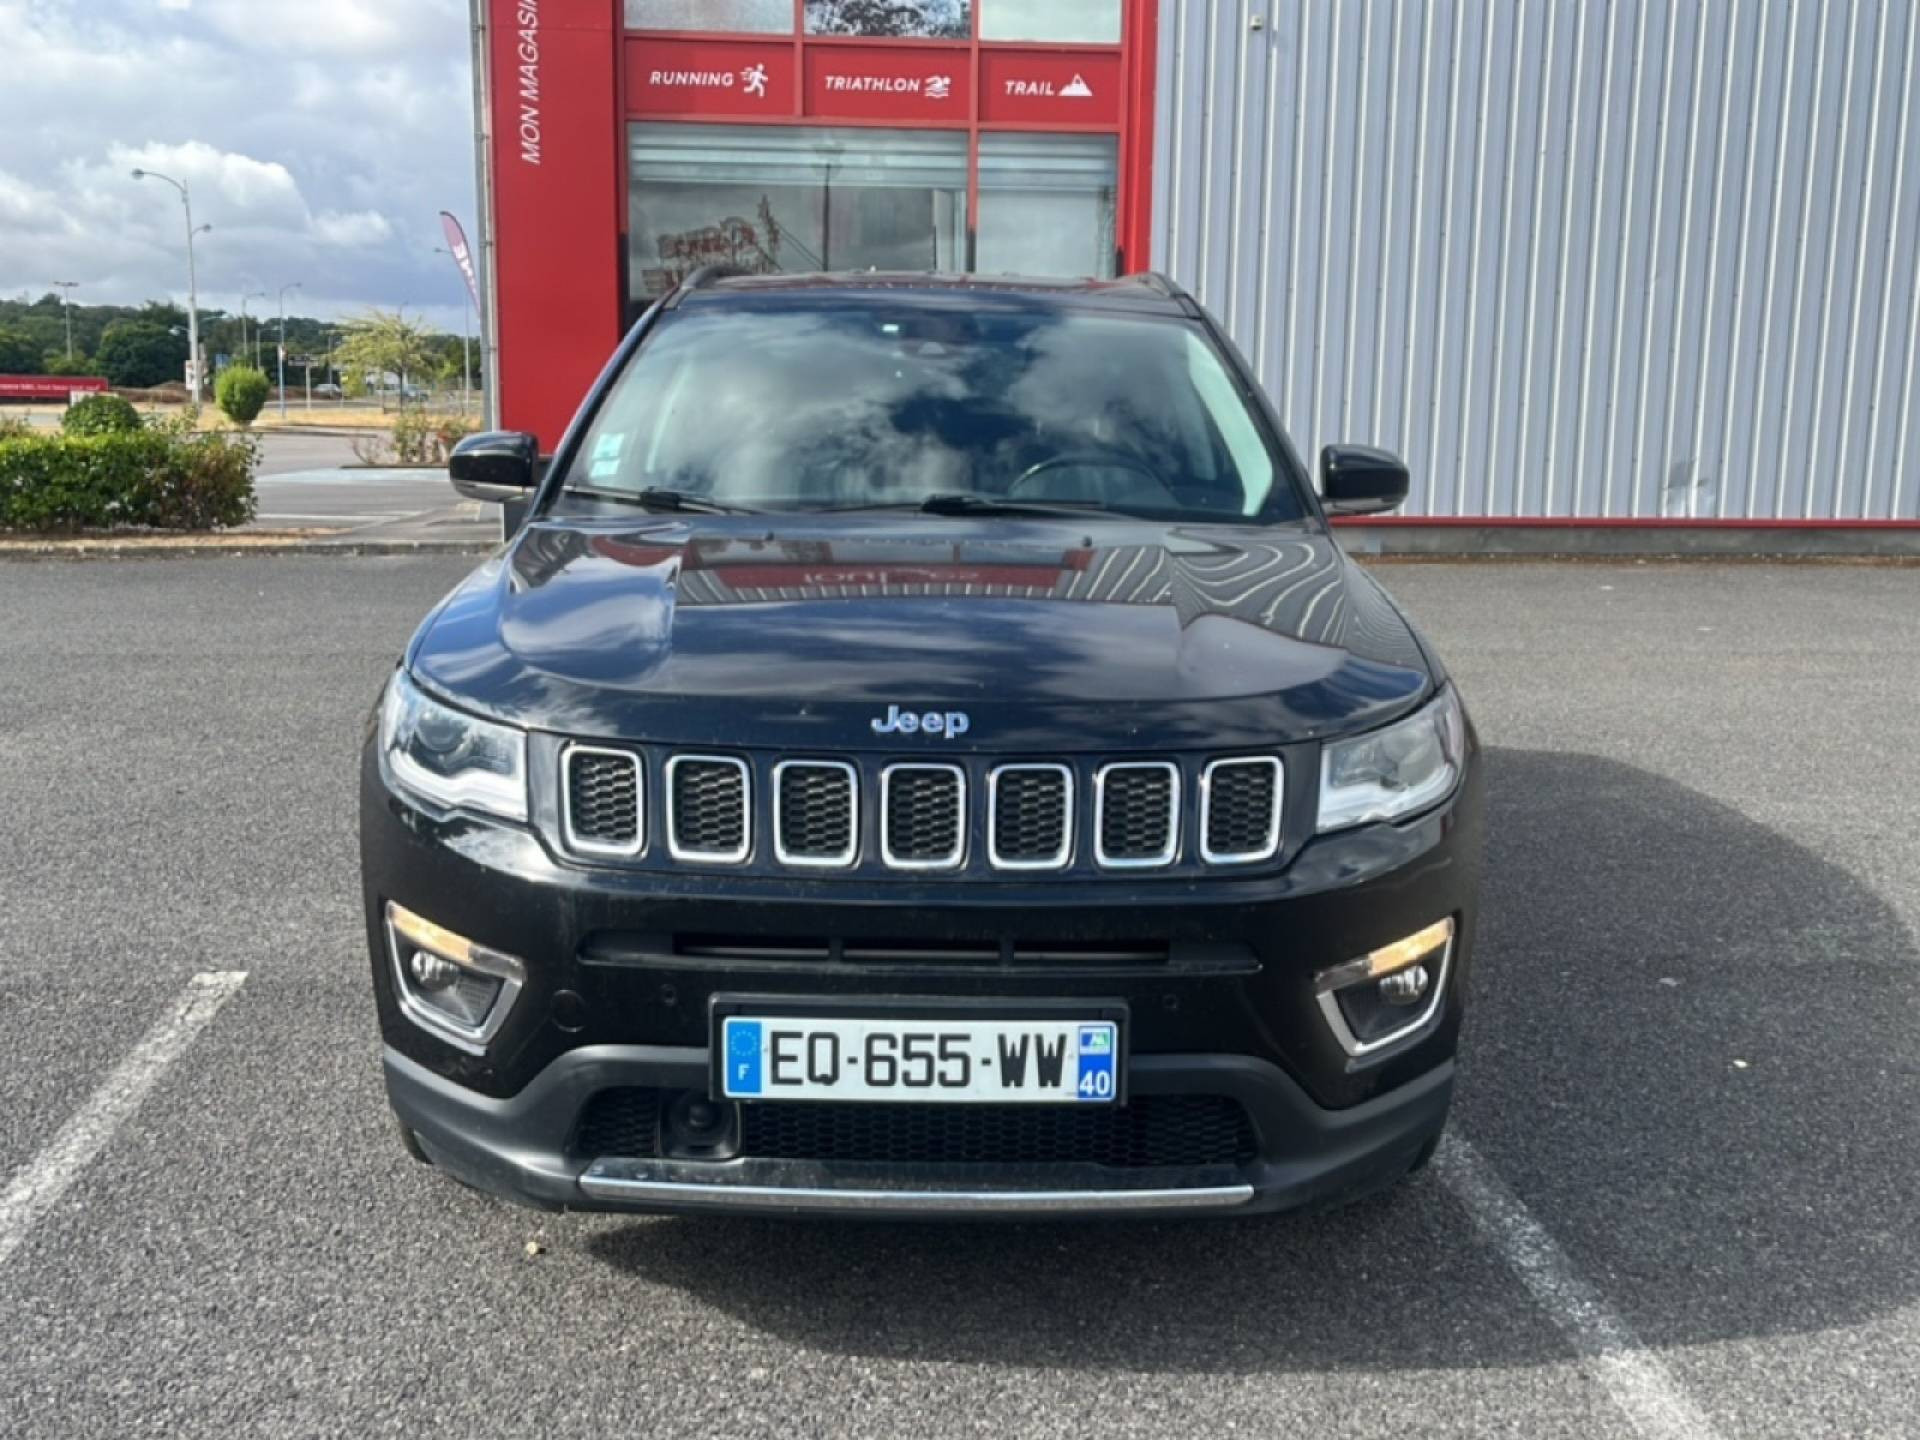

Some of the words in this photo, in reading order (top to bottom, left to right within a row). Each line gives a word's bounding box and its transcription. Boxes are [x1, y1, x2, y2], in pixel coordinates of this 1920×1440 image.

[650, 71, 734, 86] RUNNING
[825, 75, 920, 92] TRIATHLON
[1005, 80, 1055, 96] TRAIL
[520, 104, 541, 165] MON
[871, 704, 969, 739] Jeep
[771, 1031, 1067, 1087] EQ-655-WW
[737, 1063, 750, 1080] F
[1079, 1070, 1111, 1096] 40
